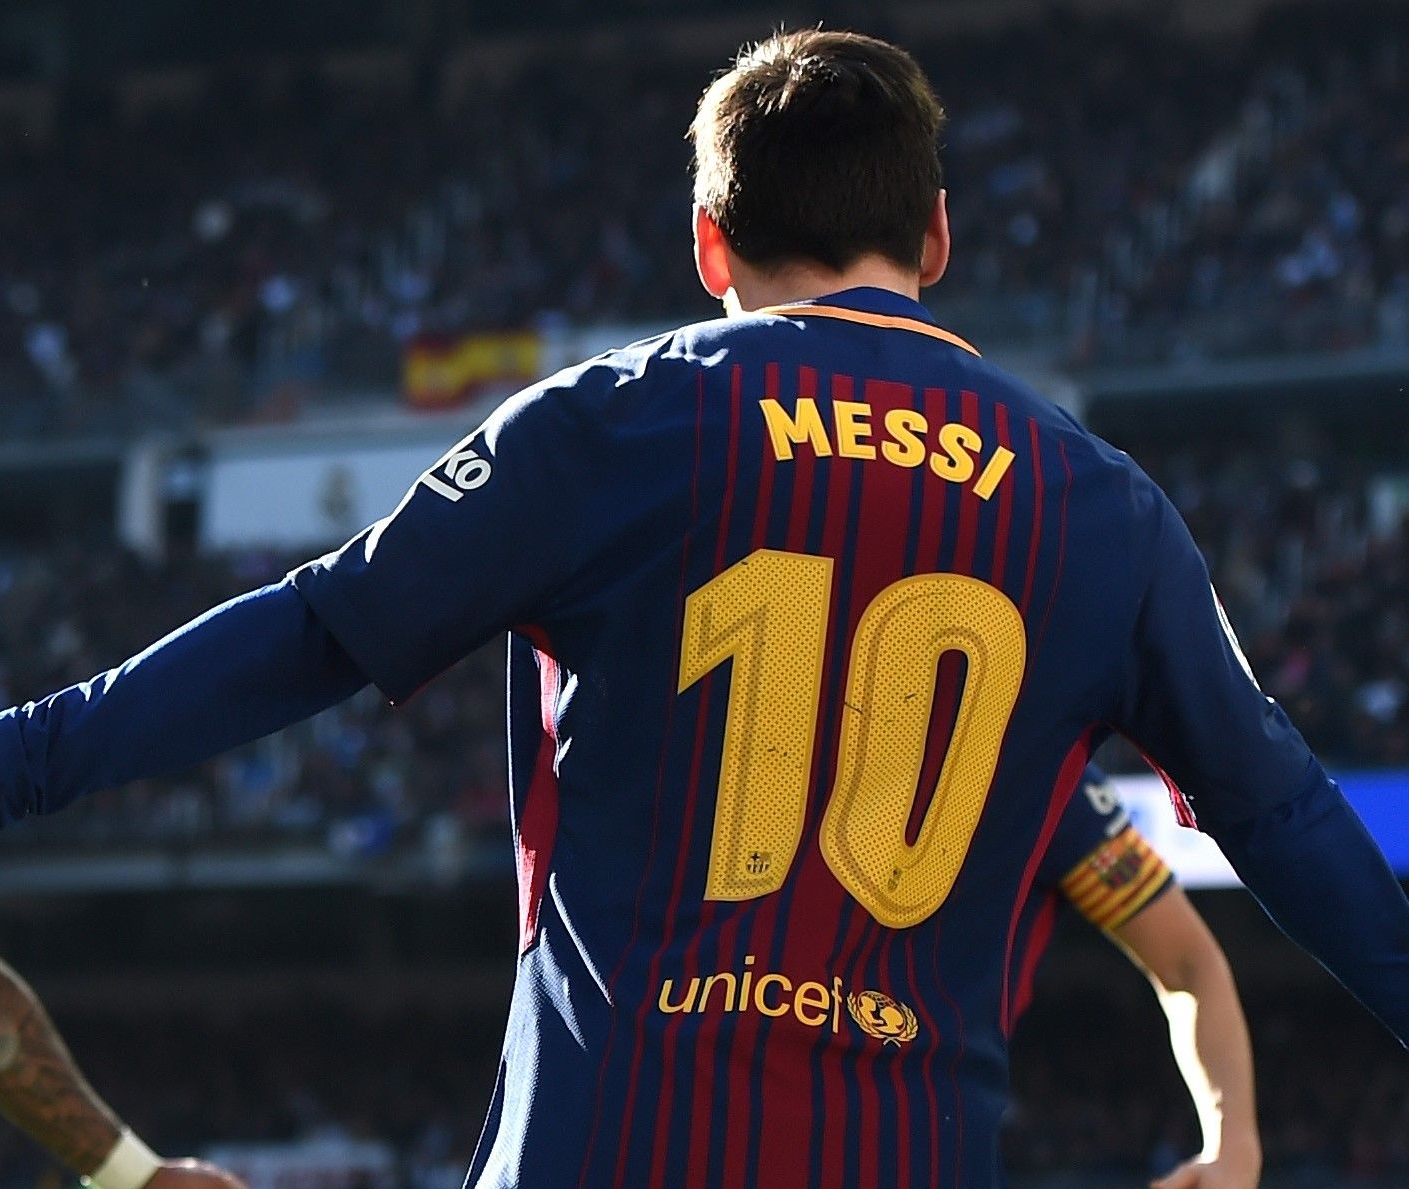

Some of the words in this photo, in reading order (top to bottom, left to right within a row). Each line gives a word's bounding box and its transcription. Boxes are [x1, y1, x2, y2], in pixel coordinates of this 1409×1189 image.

[759, 397, 1016, 501] MESSI
[677, 548, 1027, 930] 10
[657, 955, 843, 1034] unicef
